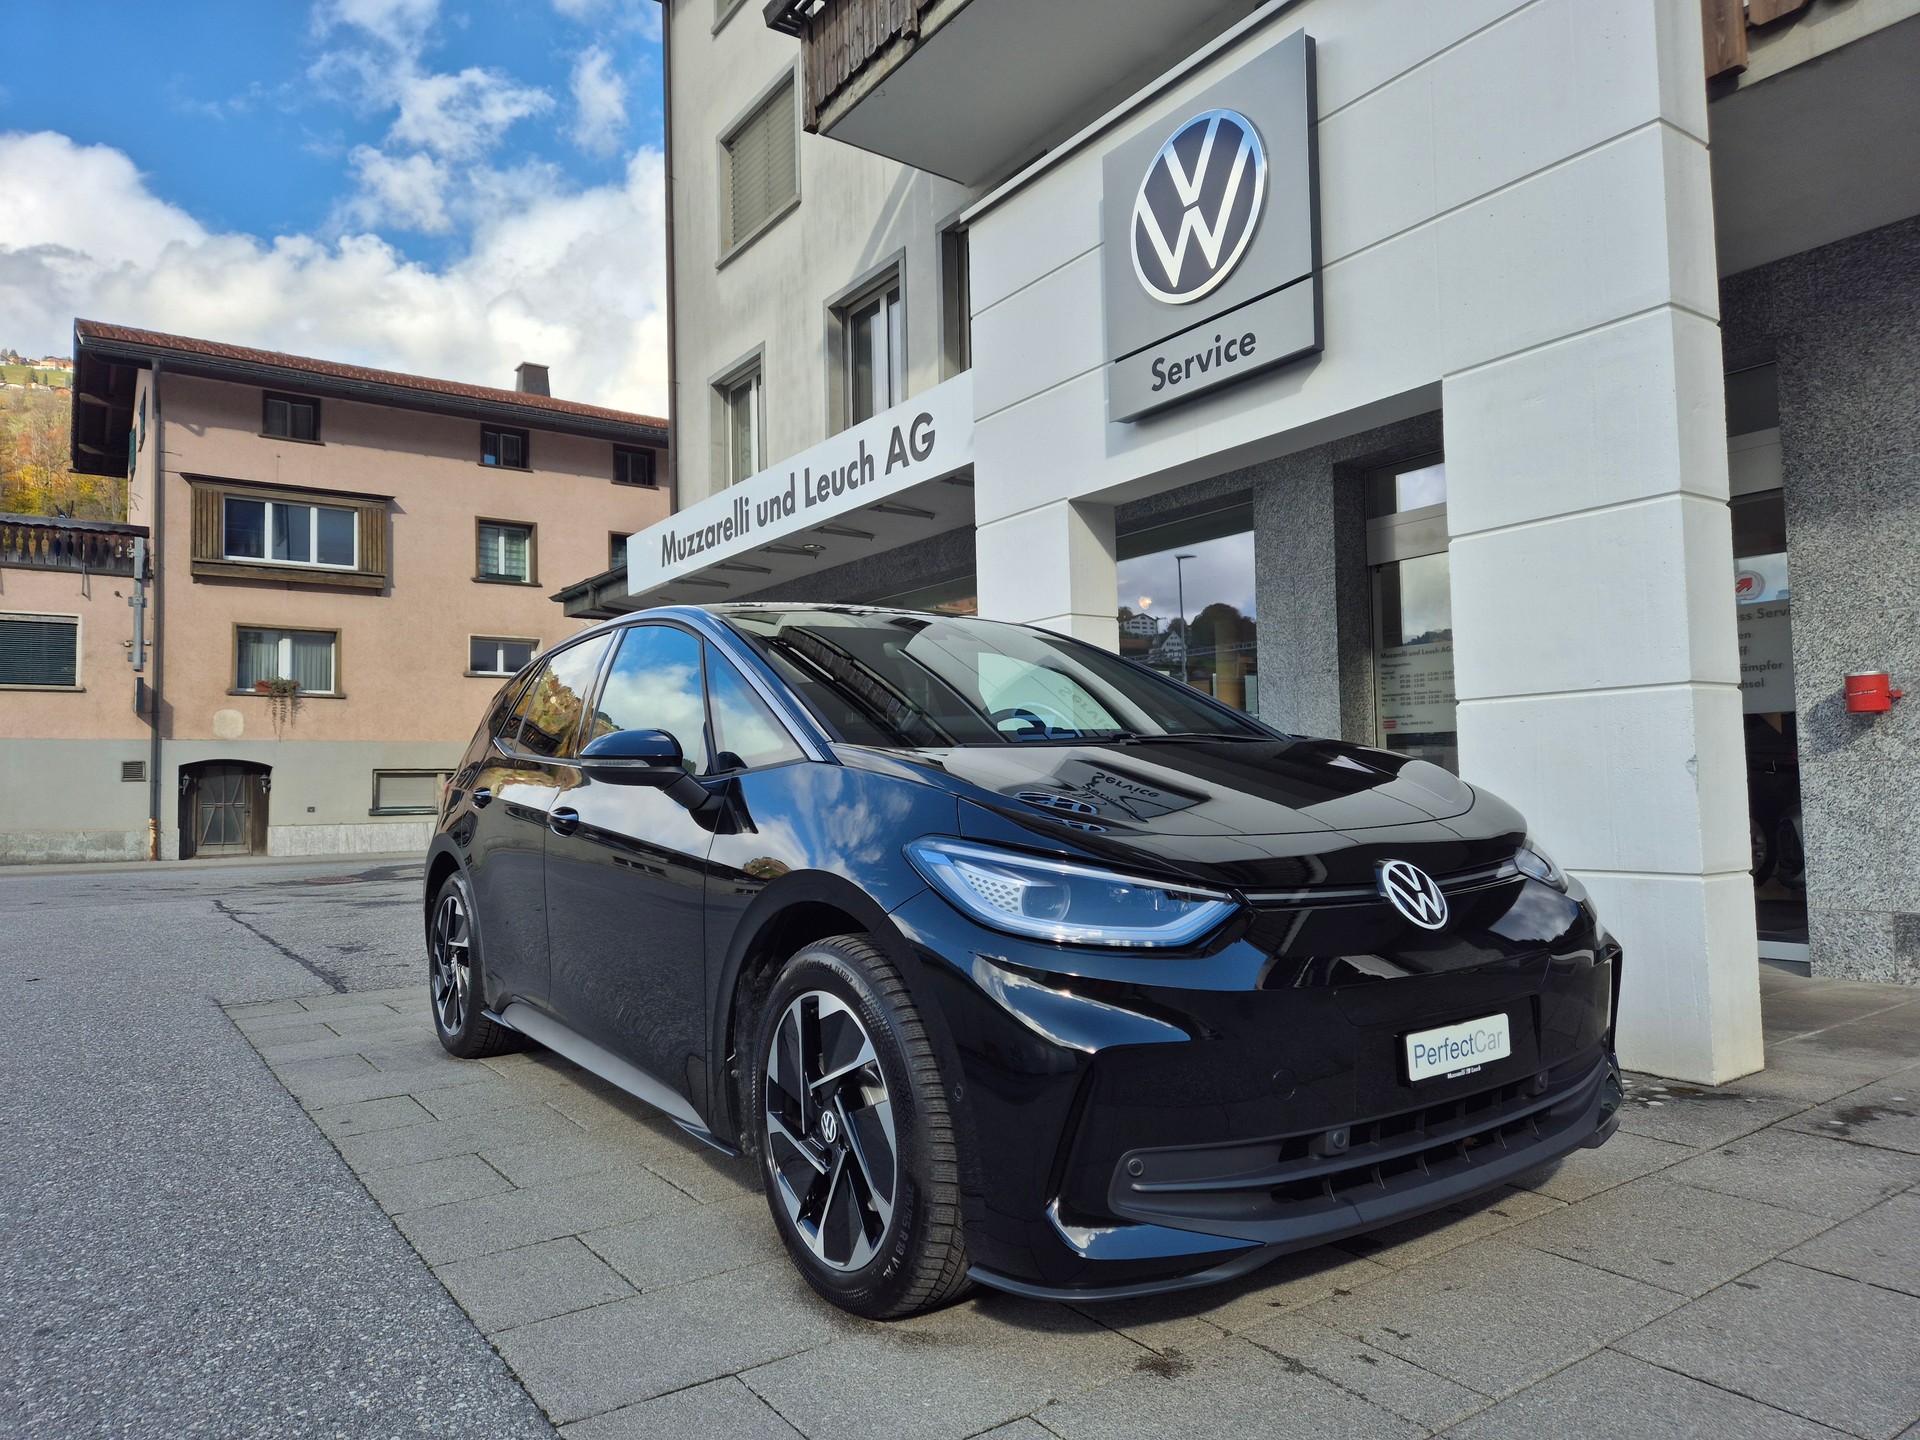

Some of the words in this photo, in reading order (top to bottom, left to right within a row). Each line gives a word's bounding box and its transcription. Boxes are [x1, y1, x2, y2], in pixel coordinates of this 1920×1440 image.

[1151, 332, 1256, 392] Service
[661, 496, 750, 568] Muzzarelli
[756, 473, 796, 528] und
[804, 439, 875, 508] Leuch
[885, 412, 935, 475] AG
[1440, 645, 1452, 653] AG
[1414, 1029, 1502, 1069] PerfectCar
